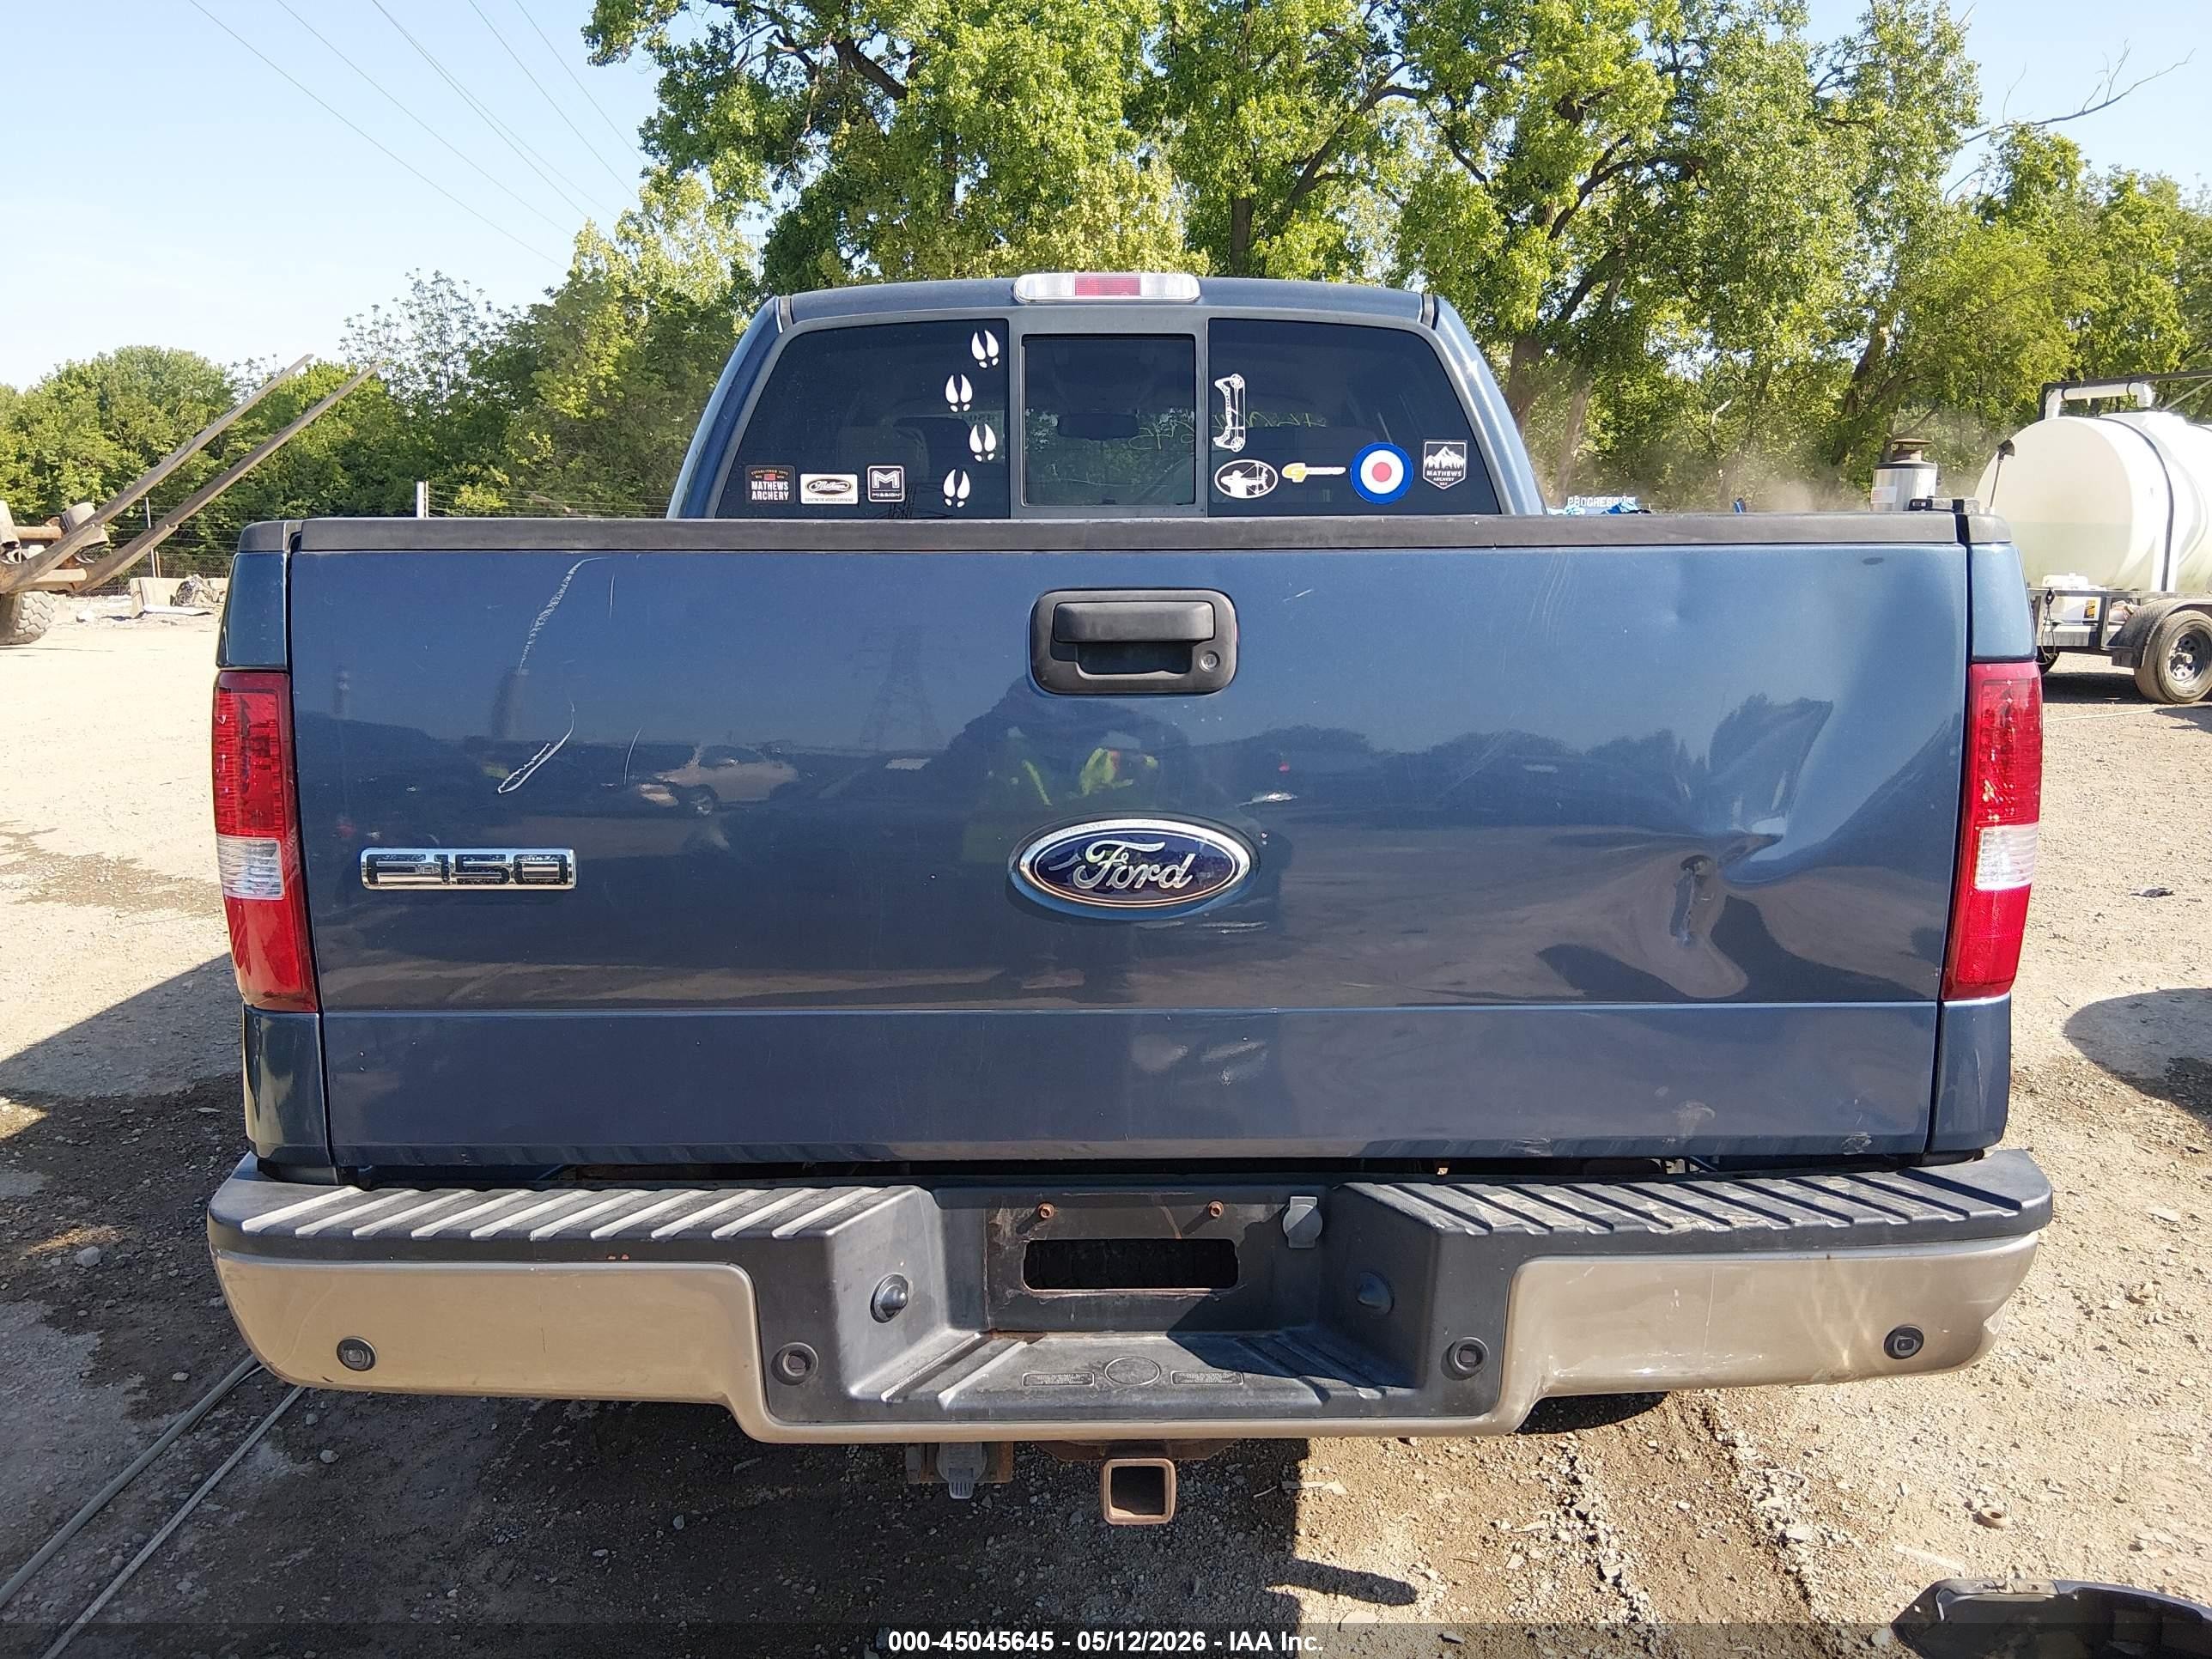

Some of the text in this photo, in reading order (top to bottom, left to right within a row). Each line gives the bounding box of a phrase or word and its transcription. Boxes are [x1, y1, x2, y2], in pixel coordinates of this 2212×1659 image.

[750, 481, 789, 490] MATHEWS
[751, 490, 789, 501] ARCHERY
[1073, 839, 1196, 889] Ford
